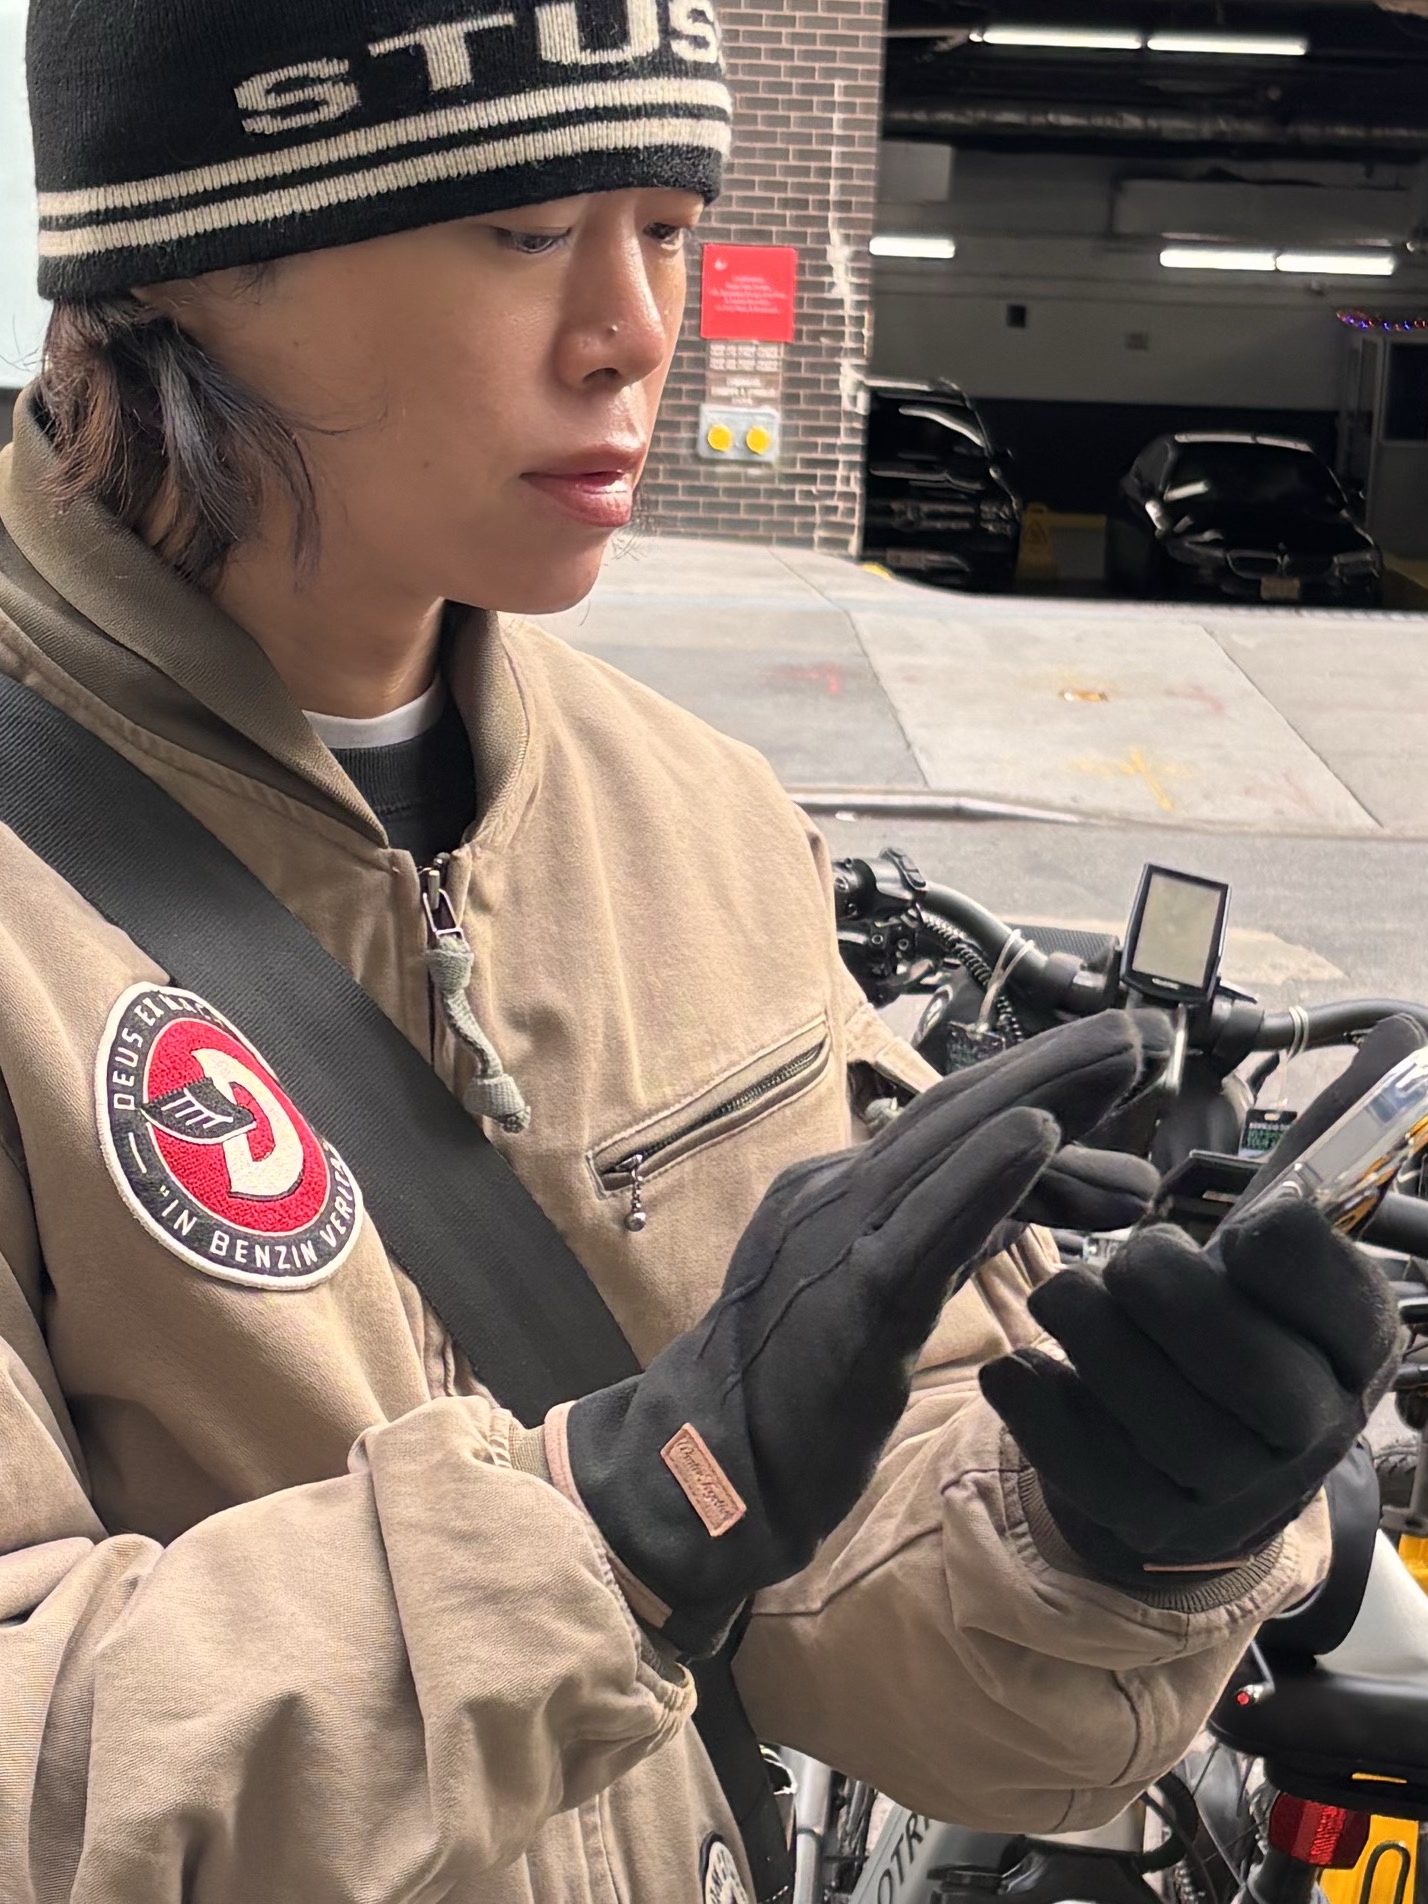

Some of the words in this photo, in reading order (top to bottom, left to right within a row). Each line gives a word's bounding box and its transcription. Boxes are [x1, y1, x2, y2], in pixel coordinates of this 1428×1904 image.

[112, 1027, 144, 1111] DEUS
[134, 997, 164, 1026] EX
[209, 1228, 318, 1270] BENZIN
[319, 1138, 353, 1248] VERITA
